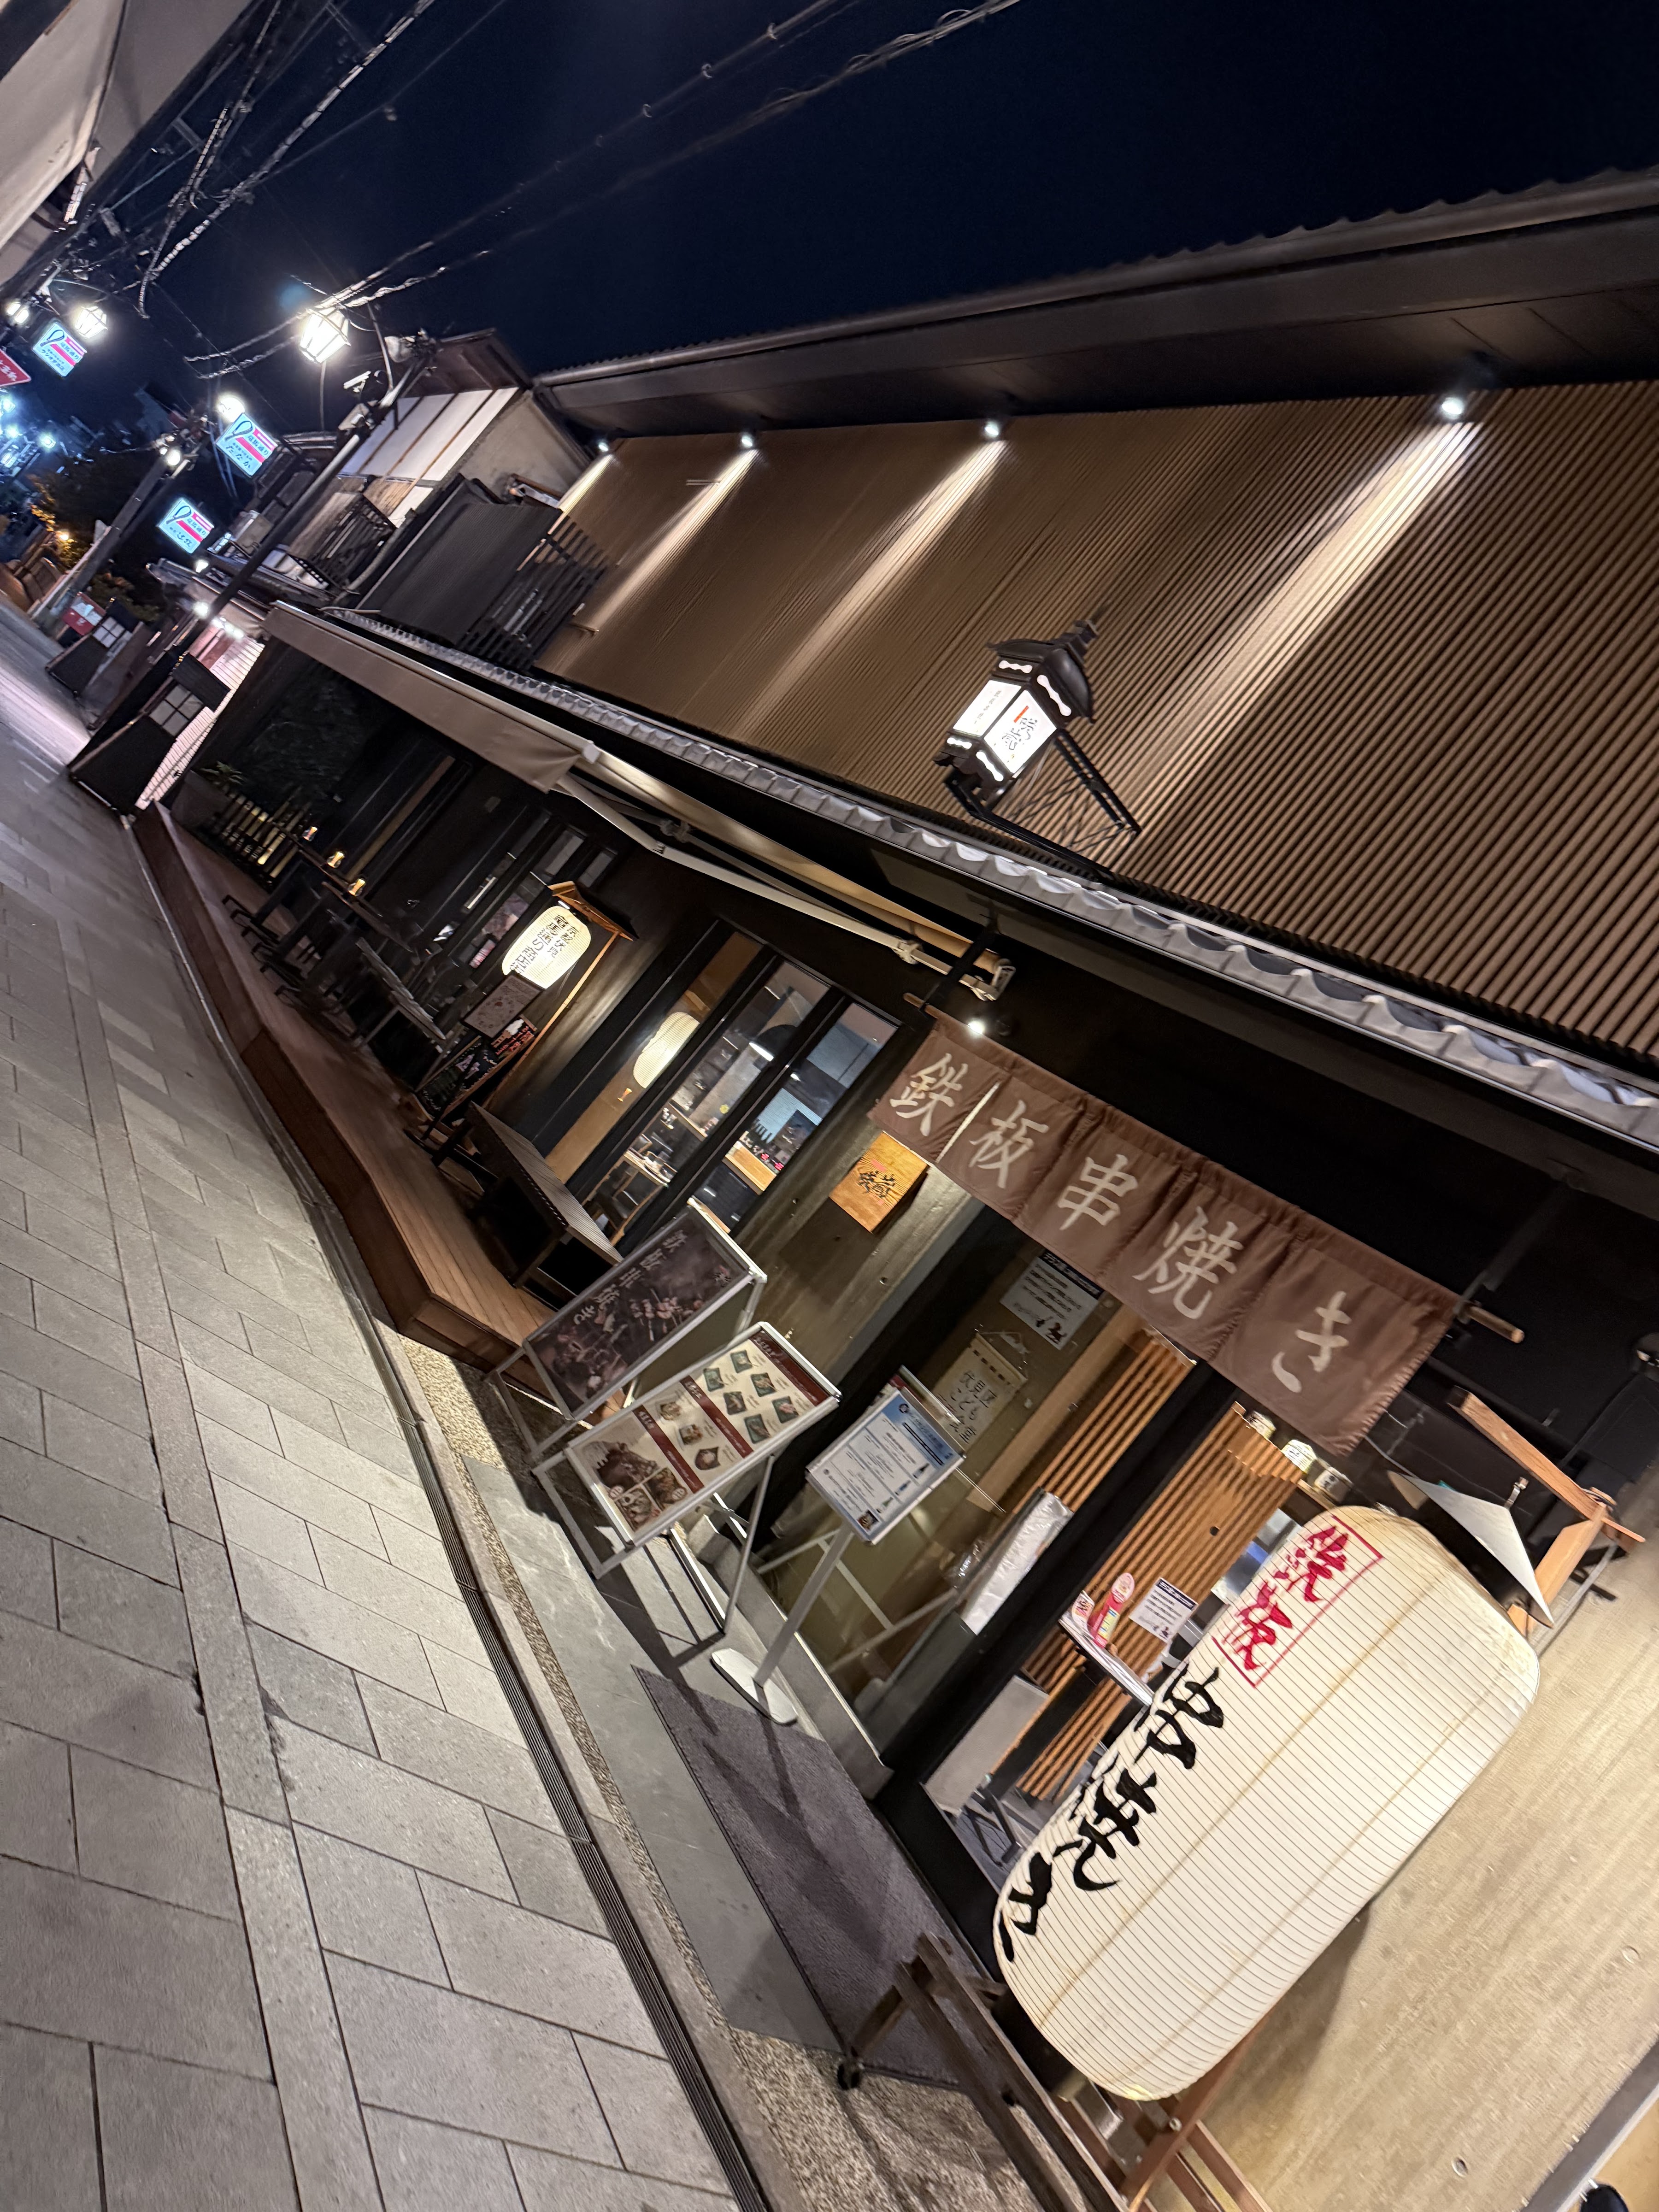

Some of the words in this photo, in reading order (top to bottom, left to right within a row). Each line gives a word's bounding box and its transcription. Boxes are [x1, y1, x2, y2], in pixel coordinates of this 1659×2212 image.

[226, 445, 251, 468] たなか
[890, 1053, 1352, 1393] 鉄板串焼き
[572, 1229, 688, 1325] 鉄板串焼き
[950, 1388, 978, 1420] こども
[959, 1370, 997, 1408] 伏見区
[1221, 1524, 1350, 1671] 鉄板
